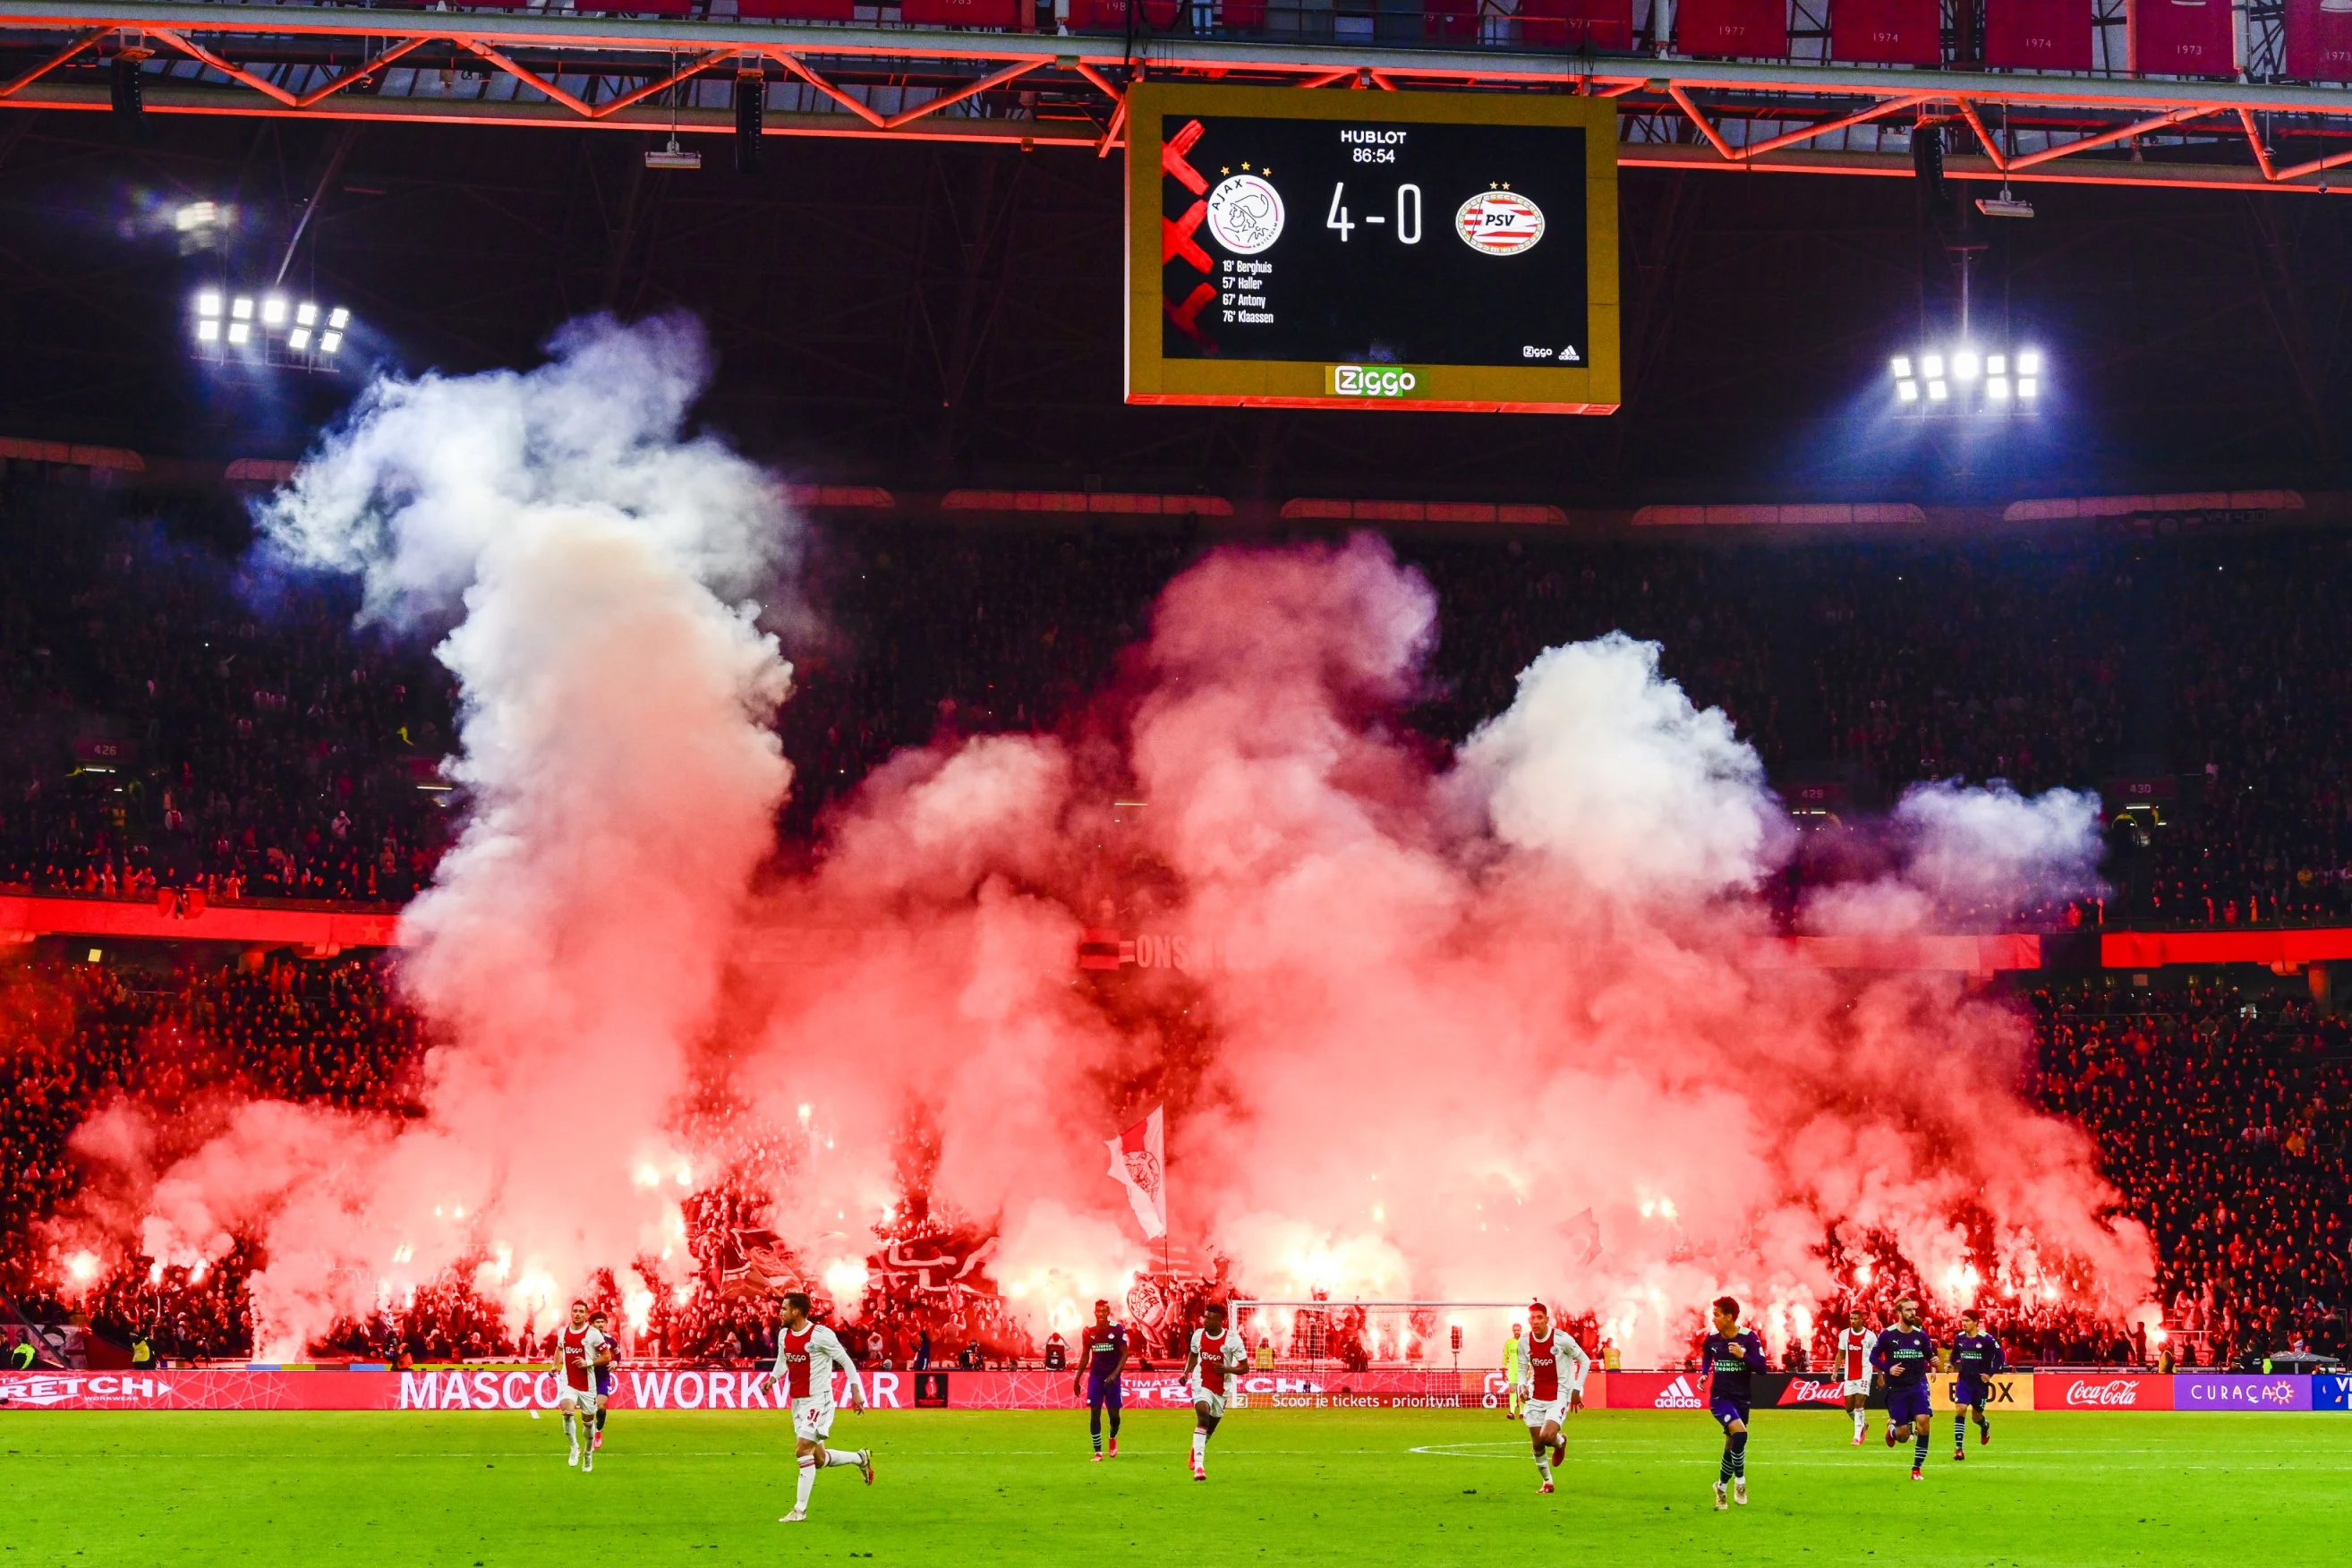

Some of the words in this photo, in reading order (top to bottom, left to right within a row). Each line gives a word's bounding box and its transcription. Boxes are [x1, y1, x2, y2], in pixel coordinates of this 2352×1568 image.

[1719, 26, 1745, 36] 1977
[1873, 32, 1898, 43] 1974
[2025, 38, 2051, 48] 1974
[2177, 45, 2202, 55] 1973
[1341, 130, 1407, 144] HUBLOT
[1352, 148, 1395, 163] 86:54
[1212, 179, 1243, 210] AJAX
[1485, 214, 1516, 226] PSV
[1237, 260, 1273, 275] Berghuis
[1238, 277, 1263, 290] Haller
[1238, 294, 1266, 309] Antony
[1238, 310, 1274, 324] Klaassen
[94, 744, 117, 756] 426
[1792, 1380, 1845, 1401] Bud
[2066, 1379, 2141, 1402] Coca-Cola
[2191, 1384, 2291, 1404] CURAÇAO
[1272, 1393, 1311, 1408] Scoor
[1316, 1393, 1328, 1409] je
[1333, 1394, 1380, 1408] tickets
[1392, 1393, 1461, 1409] priority.nl
[1654, 1395, 1702, 1409] adidas
[807, 1408, 821, 1423] 31
